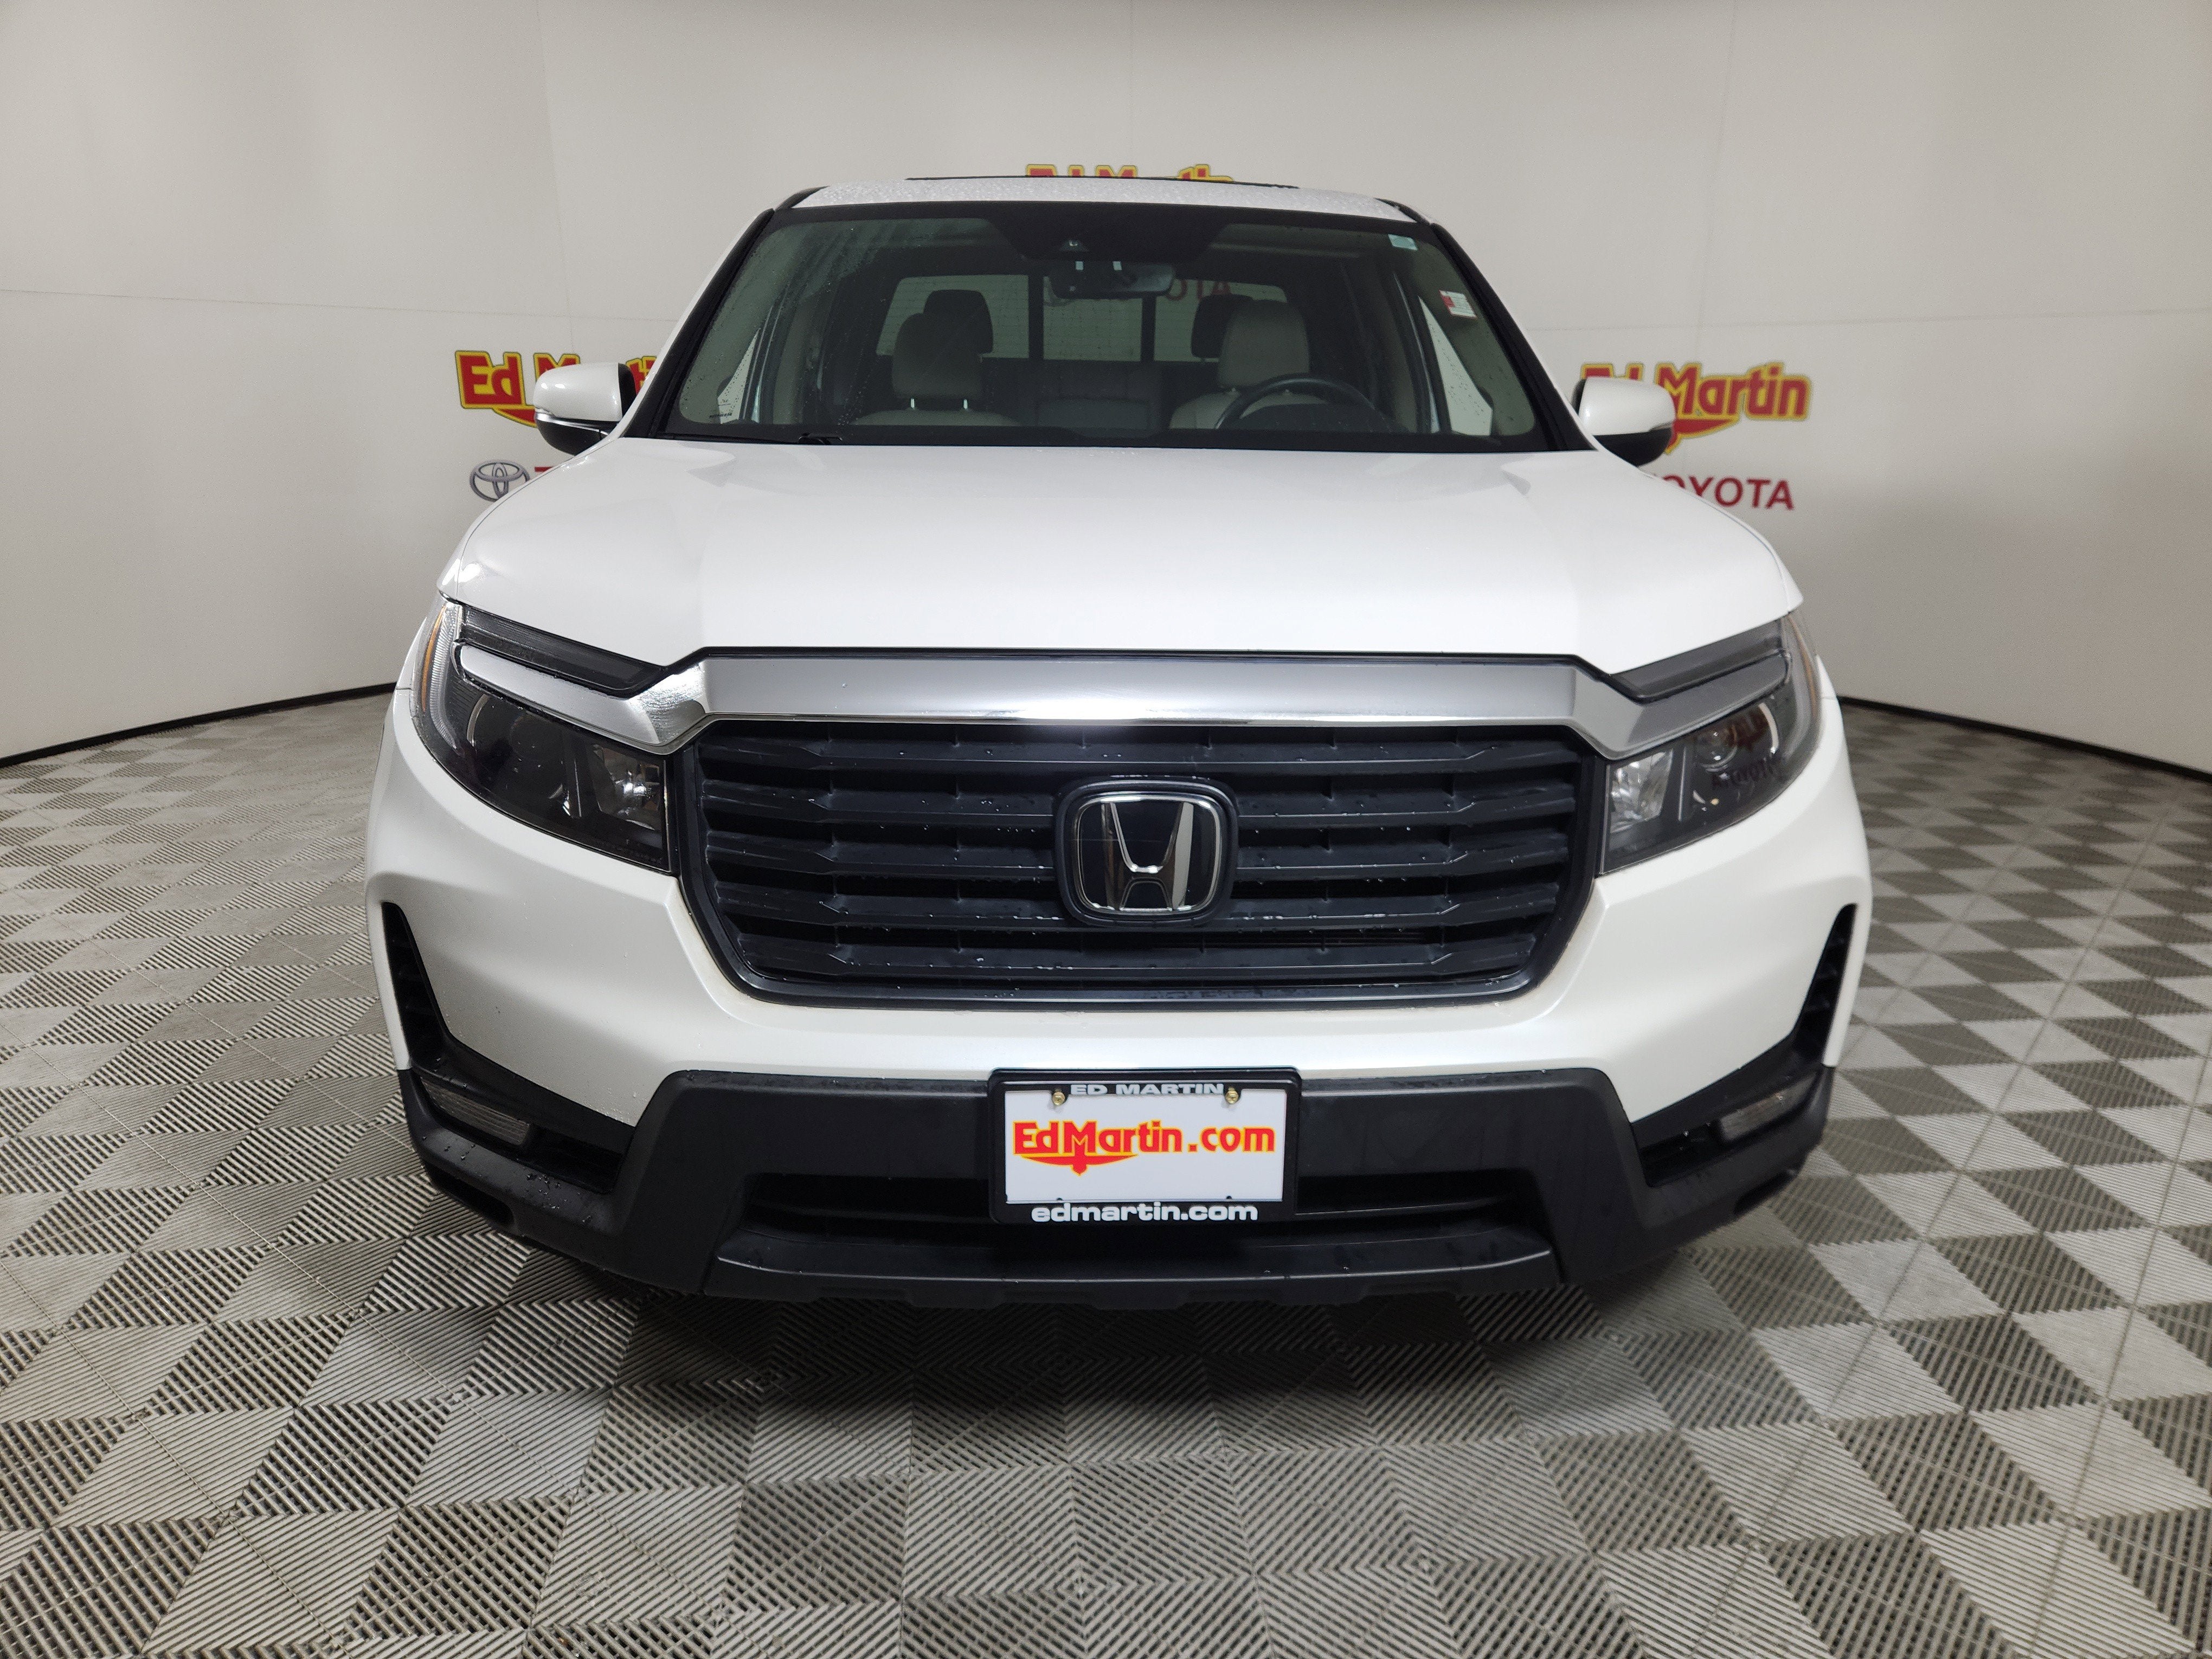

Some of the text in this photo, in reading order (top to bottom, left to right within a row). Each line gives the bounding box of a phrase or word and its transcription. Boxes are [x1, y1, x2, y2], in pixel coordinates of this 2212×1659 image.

[456, 351, 525, 408] Ed
[1663, 475, 1793, 510] YOTA
[1070, 1084, 1224, 1095] ED MARTIN
[1013, 1120, 1276, 1155] EdMartin.com
[1032, 1201, 1258, 1222] edmartin.com
